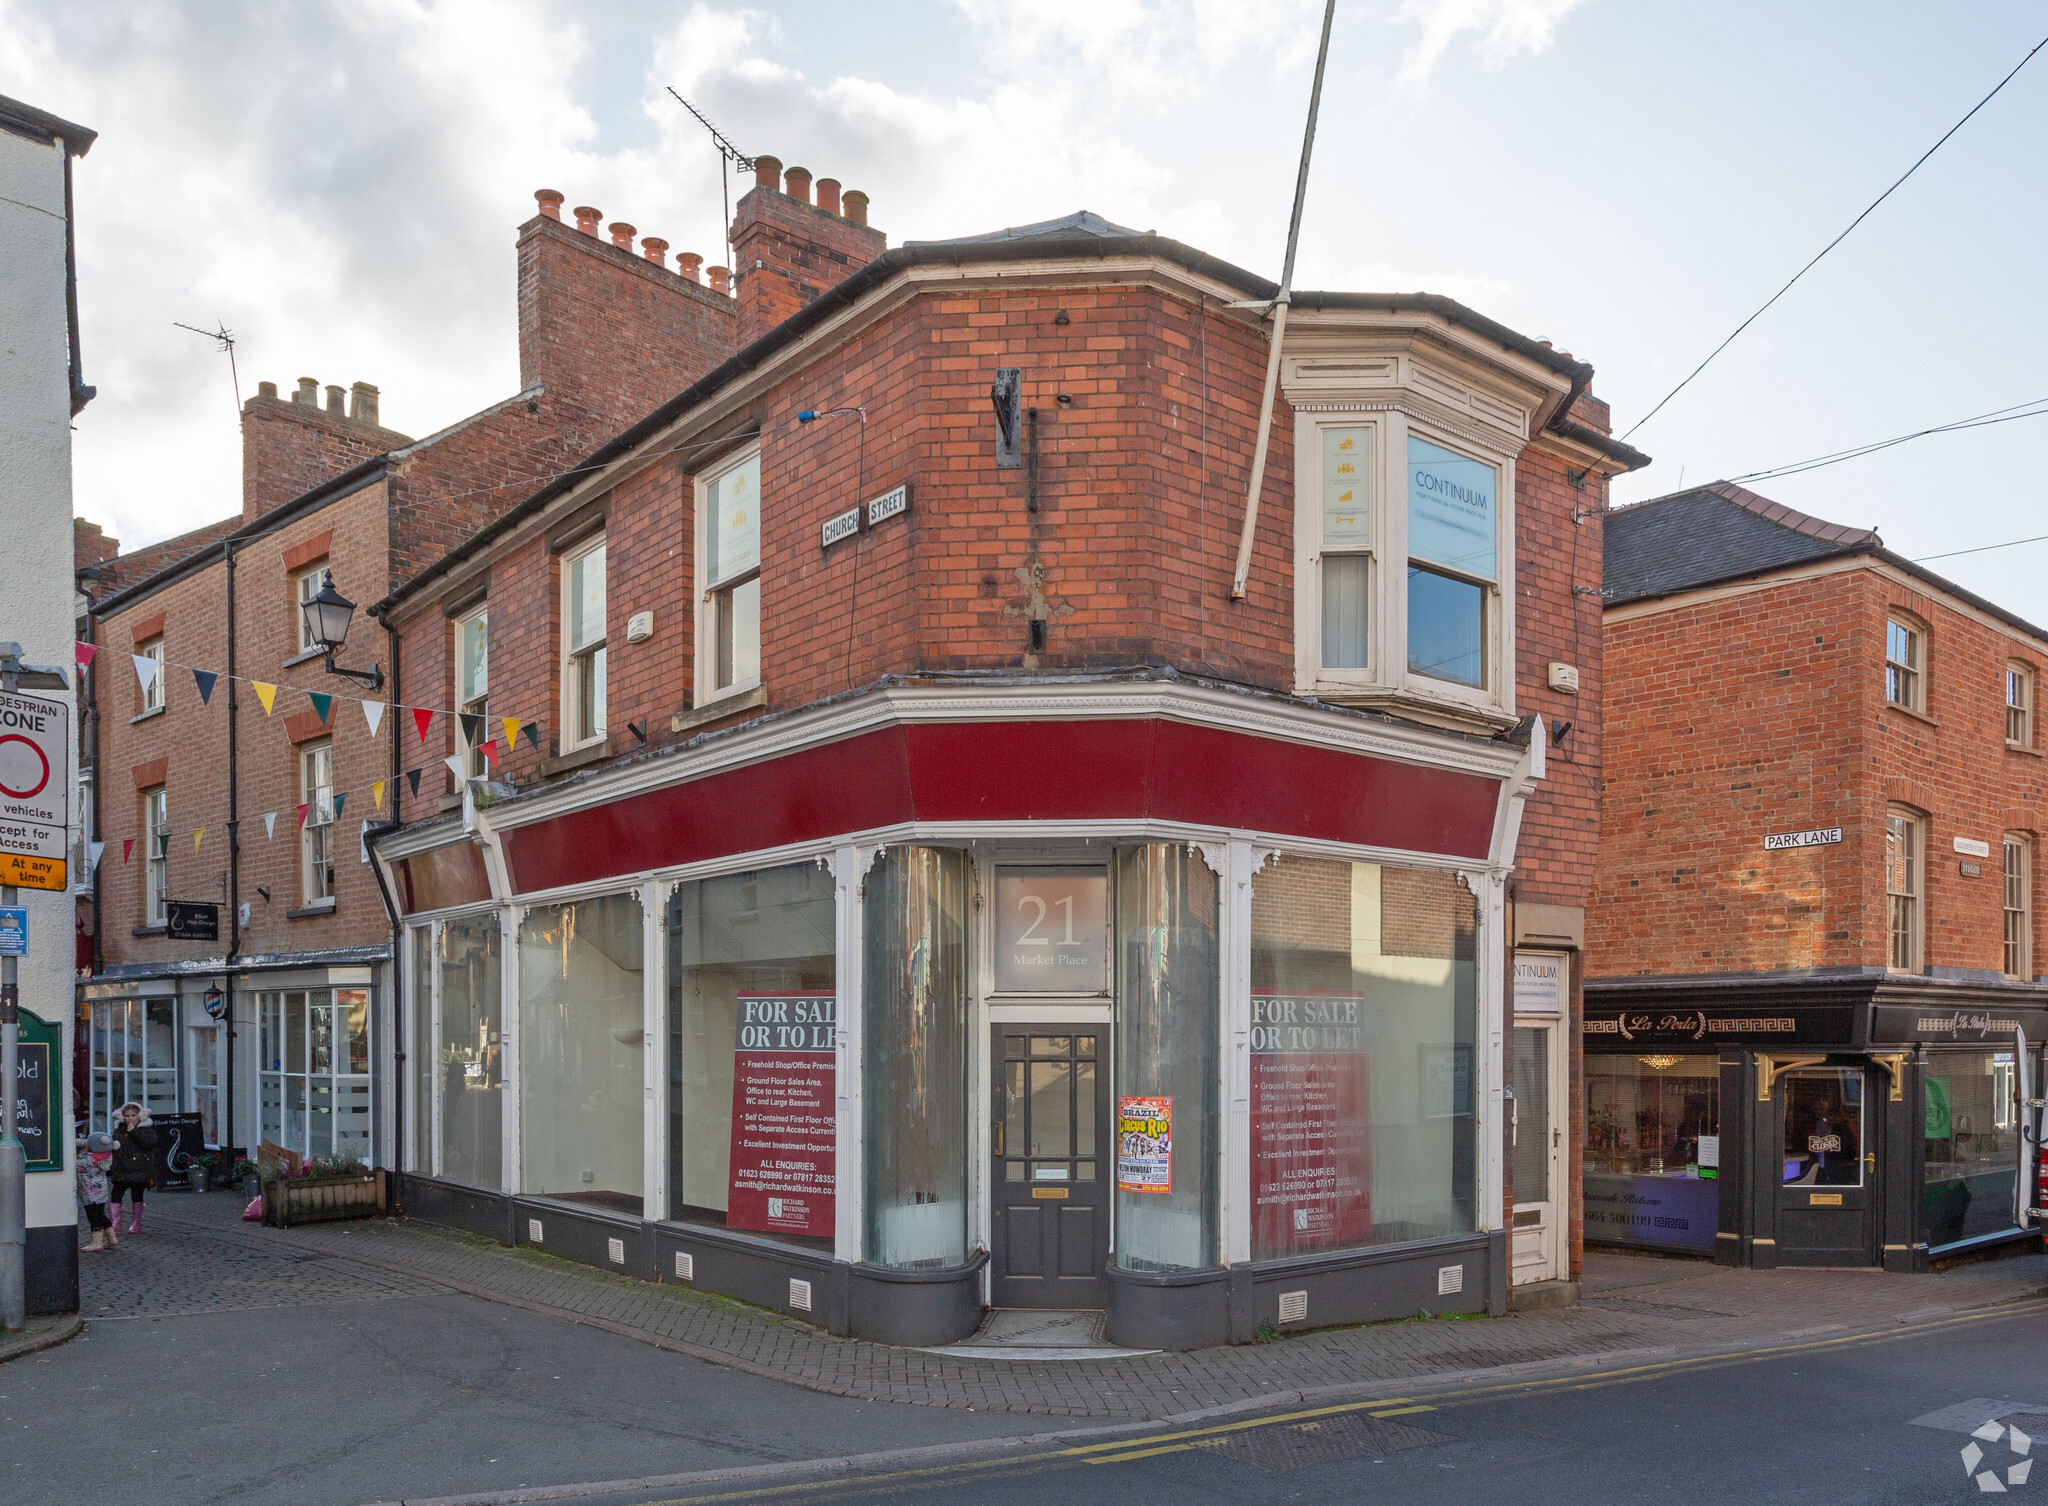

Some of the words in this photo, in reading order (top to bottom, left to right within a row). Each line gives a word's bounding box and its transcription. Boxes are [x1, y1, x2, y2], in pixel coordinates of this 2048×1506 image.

[1416, 471, 1487, 510] CONTINUUM
[824, 511, 858, 542] CHURCH
[871, 490, 904, 520] STREET
[0, 708, 46, 733] ONE
[4, 804, 54, 820] vehicles
[33, 828, 50, 840] for
[1768, 833, 1800, 848] PARK
[1804, 829, 1838, 844] LANE
[11, 857, 26, 869] At
[32, 862, 53, 874] any
[19, 871, 46, 884] time
[1015, 895, 1081, 946] 21
[1014, 954, 1055, 965] Market
[1058, 954, 1088, 965] Place
[744, 1001, 789, 1023] FOR
[1252, 1000, 1298, 1023] FOR
[1304, 1000, 1358, 1024] SALE
[1628, 1015, 1653, 1031] La
[1656, 1015, 1698, 1031] Perla
[741, 1025, 771, 1047] OR
[777, 1025, 805, 1048] TO
[1250, 1026, 1283, 1050] OR
[1287, 1027, 1316, 1050] TO
[1321, 1027, 1361, 1049] LET
[747, 1060, 774, 1069] Freehold
[775, 1061, 811, 1070] Shop/Office
[1260, 1064, 1288, 1073] Freehold
[746, 1076, 769, 1085] Ground
[770, 1077, 787, 1085] Floor
[788, 1078, 805, 1086] Sales
[806, 1079, 822, 1087] Area,
[1260, 1082, 1284, 1090] Ground
[1285, 1081, 1303, 1089] Floor
[1303, 1081, 1320, 1089] Sales
[746, 1087, 764, 1095] Office
[773, 1089, 786, 1097] rear,
[787, 1088, 813, 1098] Kitchen,
[1261, 1093, 1280, 1101] Office
[746, 1097, 757, 1105] WC
[757, 1098, 769, 1106] and
[770, 1098, 788, 1107] Large
[788, 1098, 820, 1107] Basement
[1261, 1104, 1273, 1112] WC
[1274, 1104, 1286, 1112] and
[1306, 1103, 1336, 1111] Basement
[745, 1113, 757, 1121] Self
[757, 1113, 788, 1123] Contained
[789, 1115, 804, 1124] First
[805, 1116, 822, 1124] Floor
[1123, 1109, 1159, 1117] BRAZIL
[744, 1124, 757, 1132] with
[758, 1124, 785, 1133] Separate
[786, 1125, 809, 1134] Access
[1119, 1115, 1147, 1135] CIRCUS
[1147, 1117, 1168, 1139] RIO
[1262, 1121, 1275, 1130] Self
[1276, 1120, 1308, 1129] Contained
[1308, 1120, 1323, 1128] First
[1262, 1133, 1276, 1142] with
[1277, 1132, 1304, 1142] Separate
[744, 1139, 771, 1149] Excellent
[772, 1141, 806, 1150] Investment
[1811, 1139, 1838, 1150] CLOSED
[1263, 1151, 1292, 1159] Excellent
[760, 1159, 774, 1169] ALL
[775, 1160, 817, 1171] ENQUIRIES:
[738, 1169, 758, 1178] 01623
[759, 1170, 783, 1180] 626990
[793, 1173, 813, 1182] 07817
[1282, 1170, 1297, 1179] ALL
[1297, 1167, 1338, 1178] ENQUIRES:
[1260, 1182, 1280, 1192] 01623
[1281, 1181, 1306, 1191] 626990
[1307, 1181, 1314, 1189] or
[783, 1205, 811, 1213] WATKINSON
[783, 1212, 806, 1221] PARTNERS
